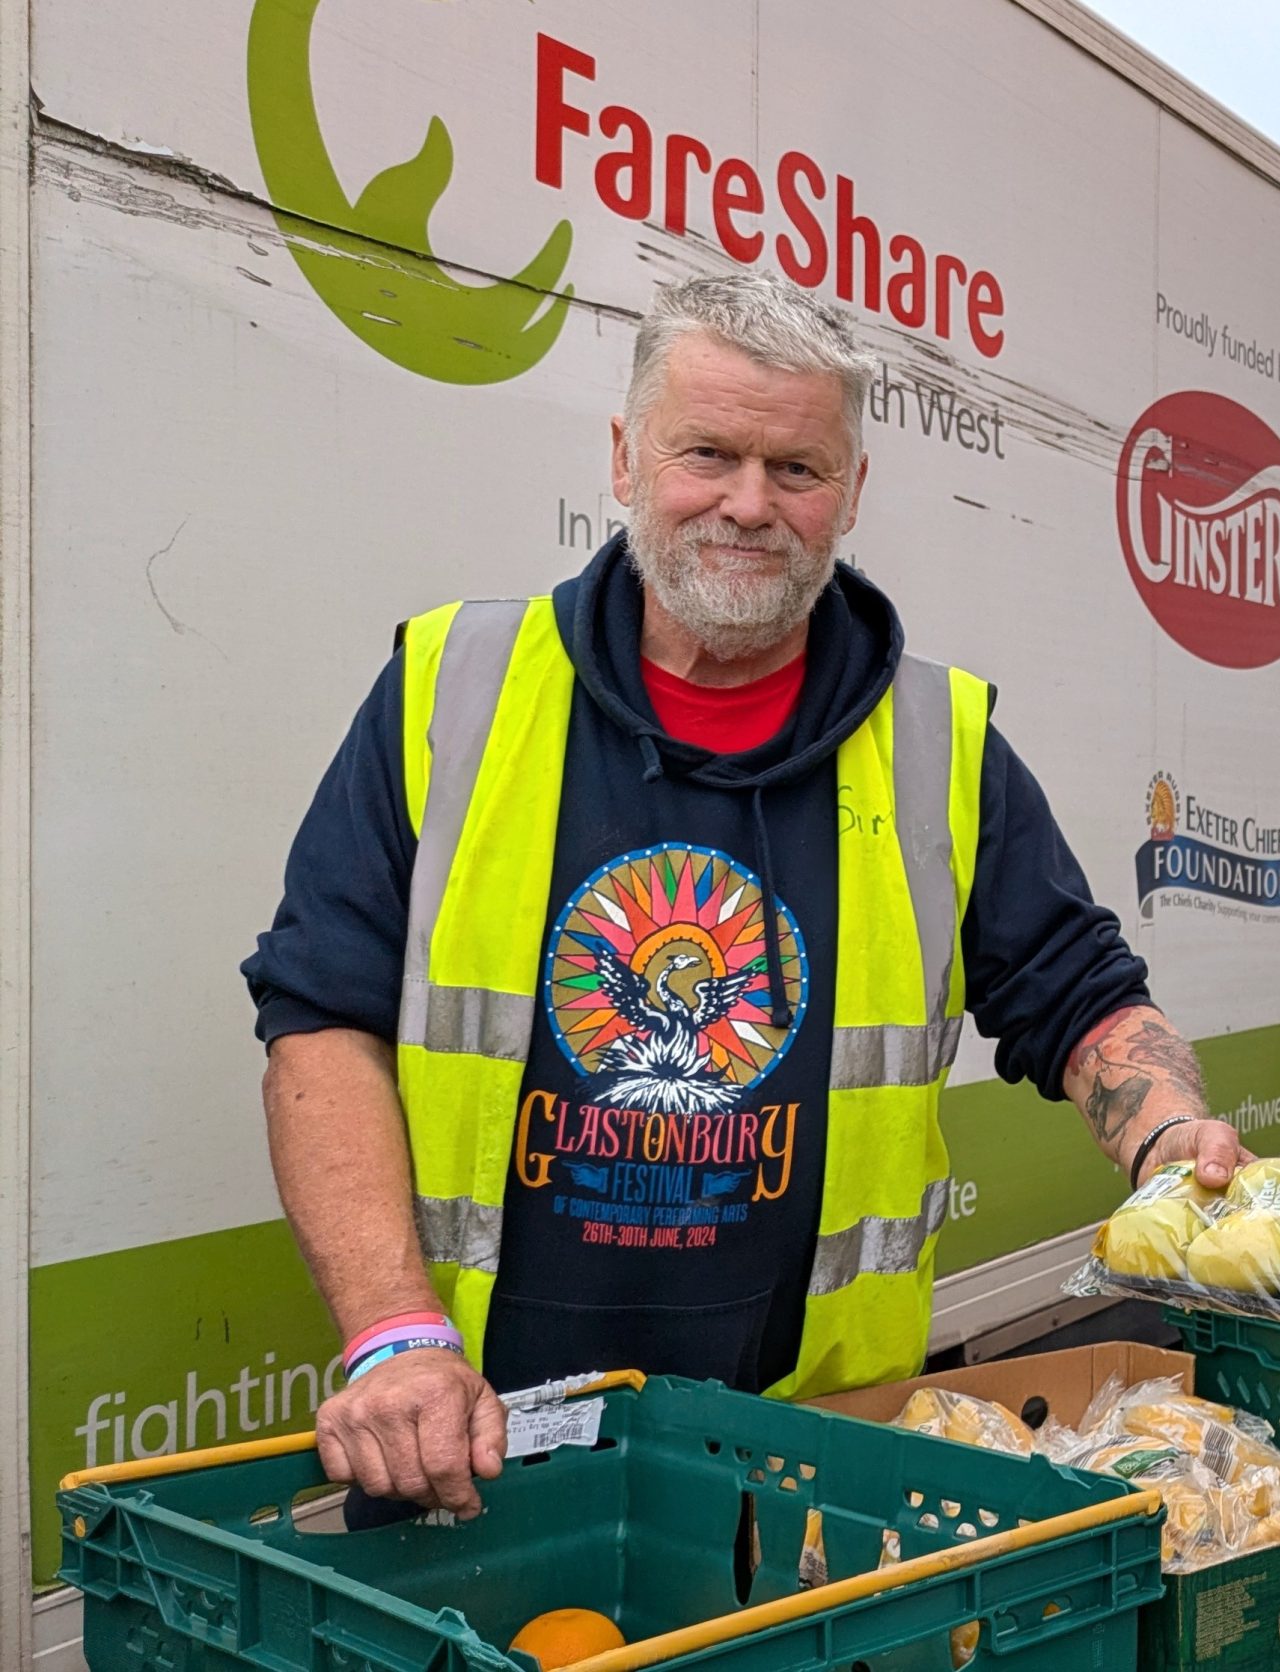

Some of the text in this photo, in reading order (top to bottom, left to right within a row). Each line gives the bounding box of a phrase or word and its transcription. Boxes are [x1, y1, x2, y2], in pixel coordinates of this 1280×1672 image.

[536, 32, 1004, 358] FareShare
[1155, 292, 1218, 358] Proudly
[1221, 324, 1274, 379] funded
[914, 380, 1006, 460] West
[559, 498, 592, 551] In
[515, 1088, 801, 1202] GLASTONBURY
[553, 1195, 568, 1215] OF
[569, 1200, 651, 1226] CONTEMPORARY
[721, 1203, 749, 1224] ARTS
[611, 1162, 696, 1205] FESTIVAL
[582, 1221, 717, 1250] 26TH-30TH JUNE, 2024
